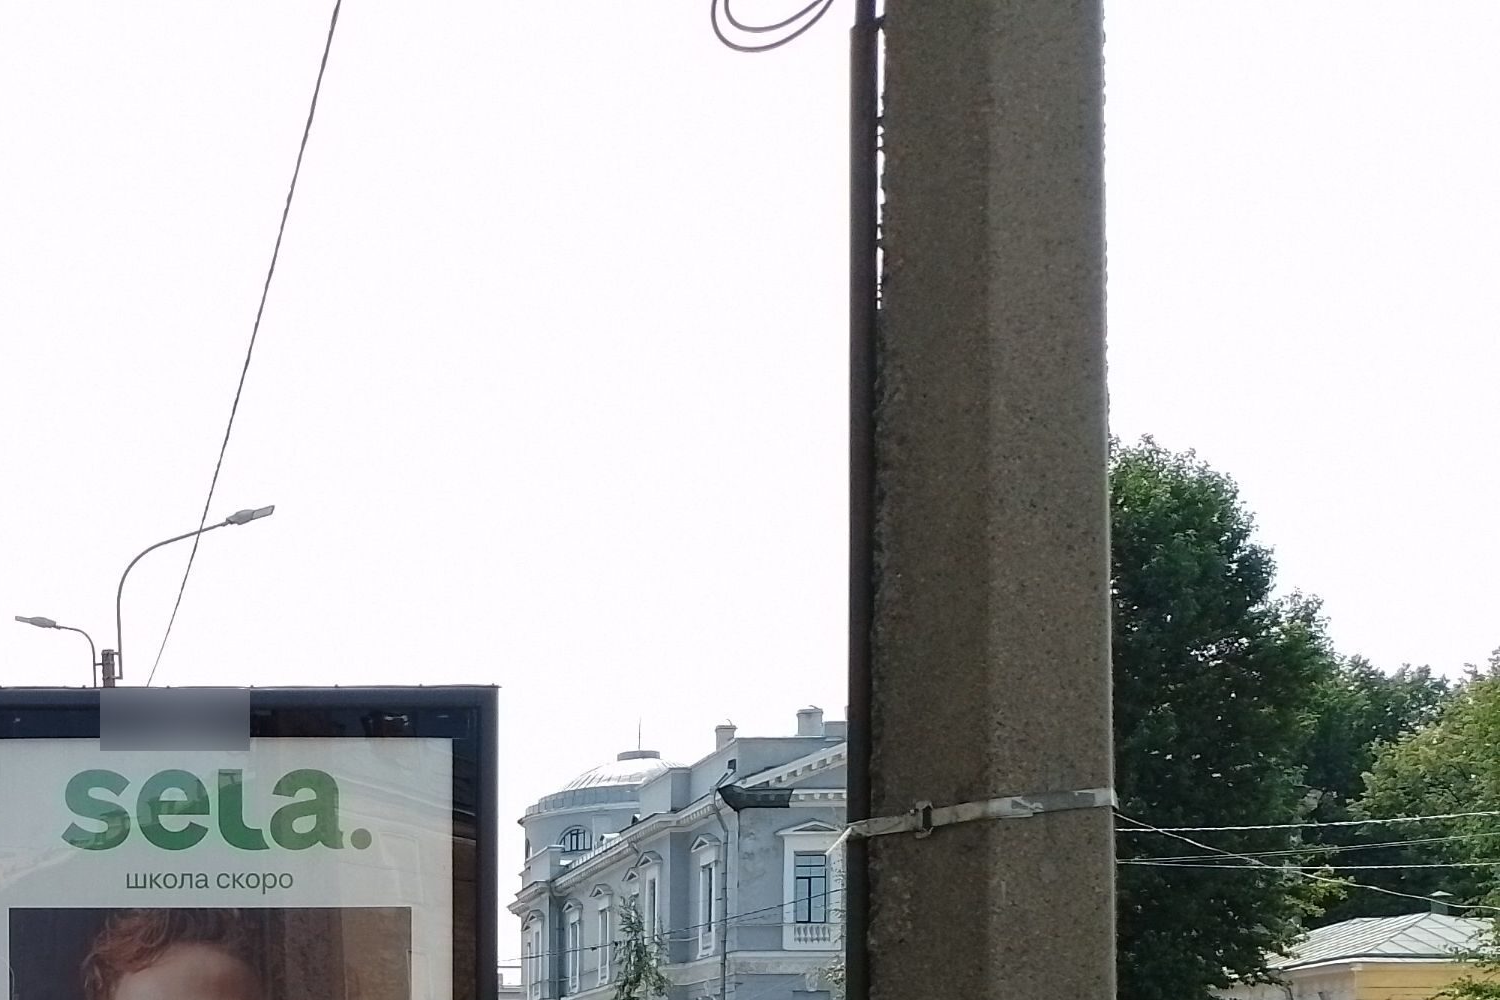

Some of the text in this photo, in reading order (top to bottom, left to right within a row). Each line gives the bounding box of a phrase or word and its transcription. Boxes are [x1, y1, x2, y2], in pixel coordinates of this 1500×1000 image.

[61, 768, 373, 851] sela.
[126, 872, 294, 895] школа скоро
